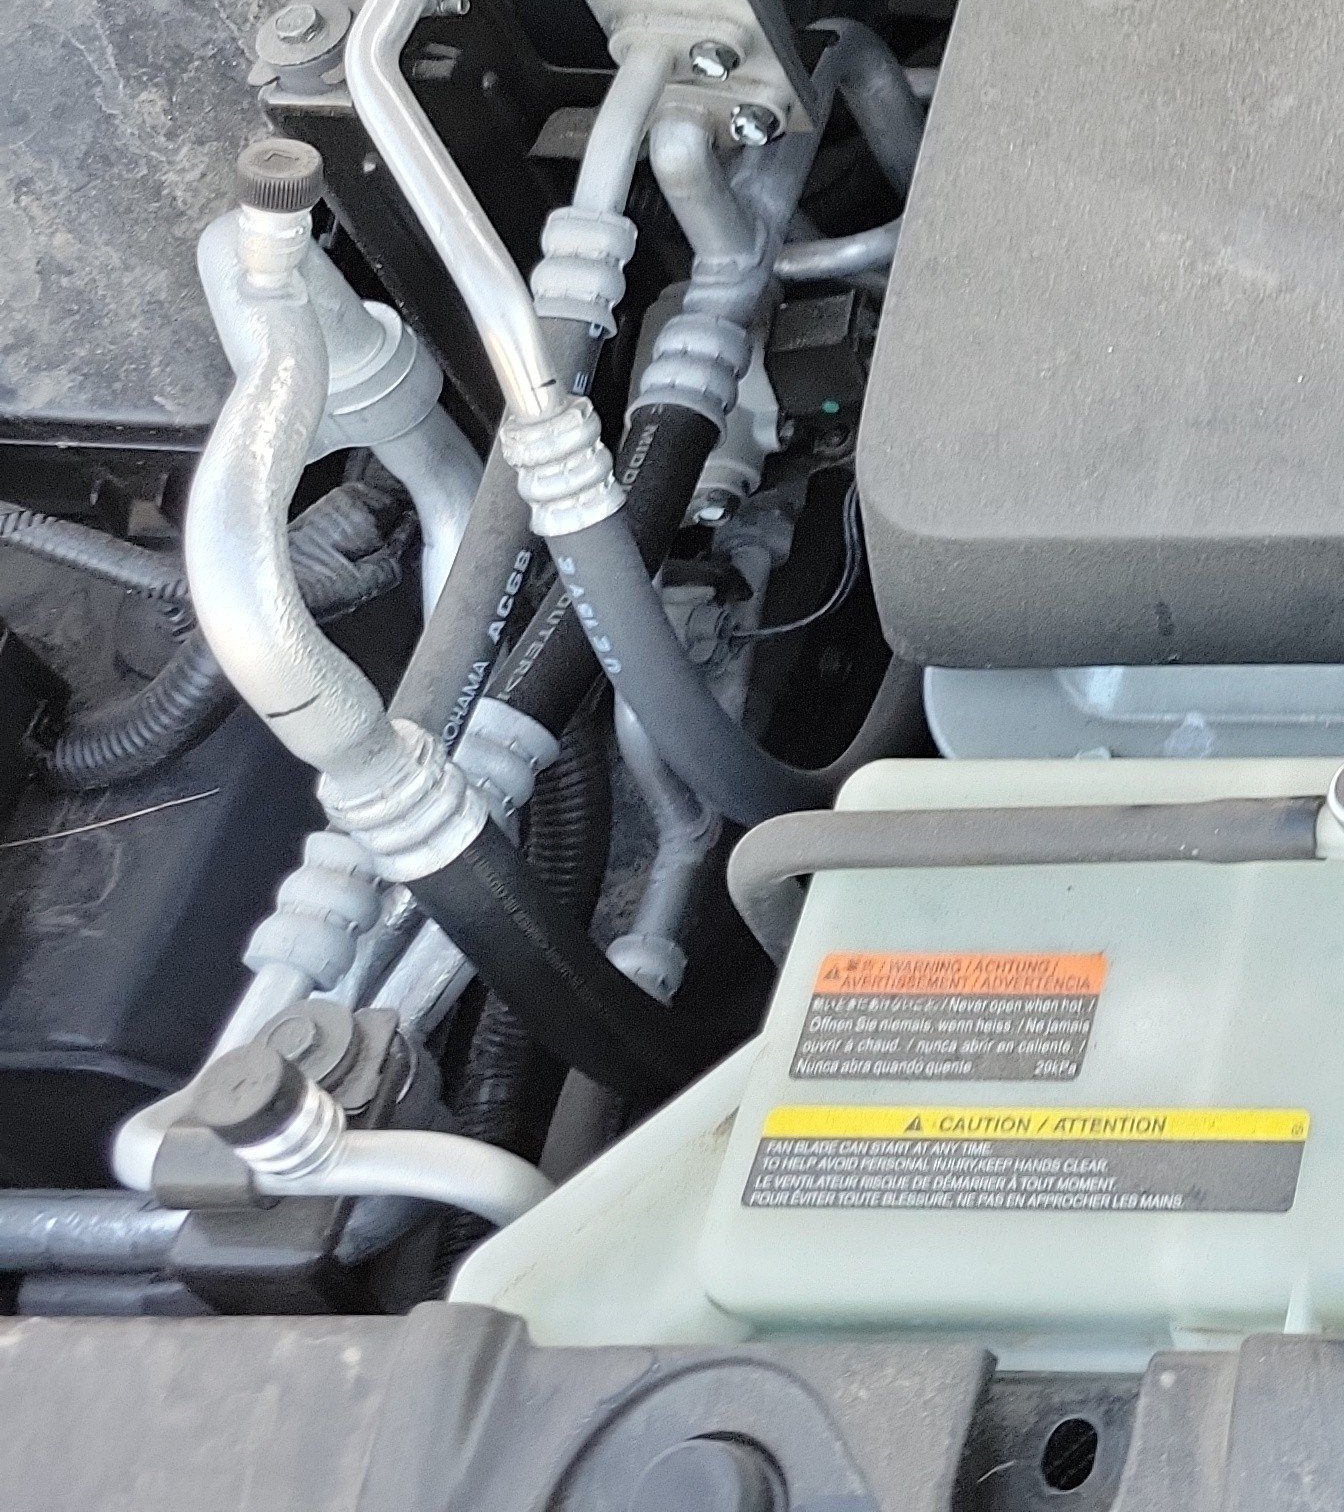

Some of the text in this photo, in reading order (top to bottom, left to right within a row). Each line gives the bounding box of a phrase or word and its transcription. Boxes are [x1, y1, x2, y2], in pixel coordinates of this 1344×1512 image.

[889, 959, 961, 974] WARNING
[973, 959, 1049, 974] ACHTUNG
[840, 974, 968, 990] AVERTISSEMENT
[950, 996, 988, 1012] Never
[989, 999, 1022, 1015] open
[1024, 997, 1059, 1013] when
[855, 1015, 878, 1033] Sie
[878, 1017, 934, 1034] niemals,
[937, 1019, 974, 1033] wenn
[1025, 1018, 1045, 1034] Ne
[1044, 1019, 1091, 1036] jamais
[802, 1039, 842, 1053] ouvrir
[857, 1038, 902, 1053] chaud.
[916, 1039, 958, 1054] nunca
[961, 1038, 995, 1054] abrir
[996, 1041, 1014, 1054] en
[1018, 1039, 1074, 1054] caliente.
[796, 1058, 839, 1074] Nunca
[840, 1057, 871, 1075] abra
[938, 1116, 1032, 1134] CAUTION
[1053, 1116, 1168, 1135] ATTENTION
[766, 1139, 795, 1155] FAN
[793, 1139, 840, 1155] BLADE
[840, 1139, 870, 1155] CAN
[870, 1139, 913, 1156] START
[912, 1139, 931, 1155] AT
[930, 1140, 961, 1156] ANY
[763, 1155, 781, 1170] TO
[781, 1155, 818, 1172] HELP
[816, 1156, 860, 1171] AVOID
[859, 1156, 930, 1172] PERSONAL
[1014, 1158, 1061, 1172] HANDS
[755, 1174, 775, 1190] LE
[774, 1174, 860, 1190] VENTILATEUR
[859, 1174, 911, 1190] RISQUE
[911, 1175, 932, 1190] DE
[1019, 1175, 1056, 1191] TOUT
[750, 1190, 790, 1206] POUR
[790, 1187, 836, 1206] ÉVITER
[838, 1190, 880, 1206] TOUTE
[955, 1191, 977, 1208] NE
[977, 1191, 1005, 1208] PAS
[1005, 1192, 1027, 1208] EN
[1025, 1192, 1112, 1209] APPROCHER
[1111, 1192, 1139, 1209] LES
